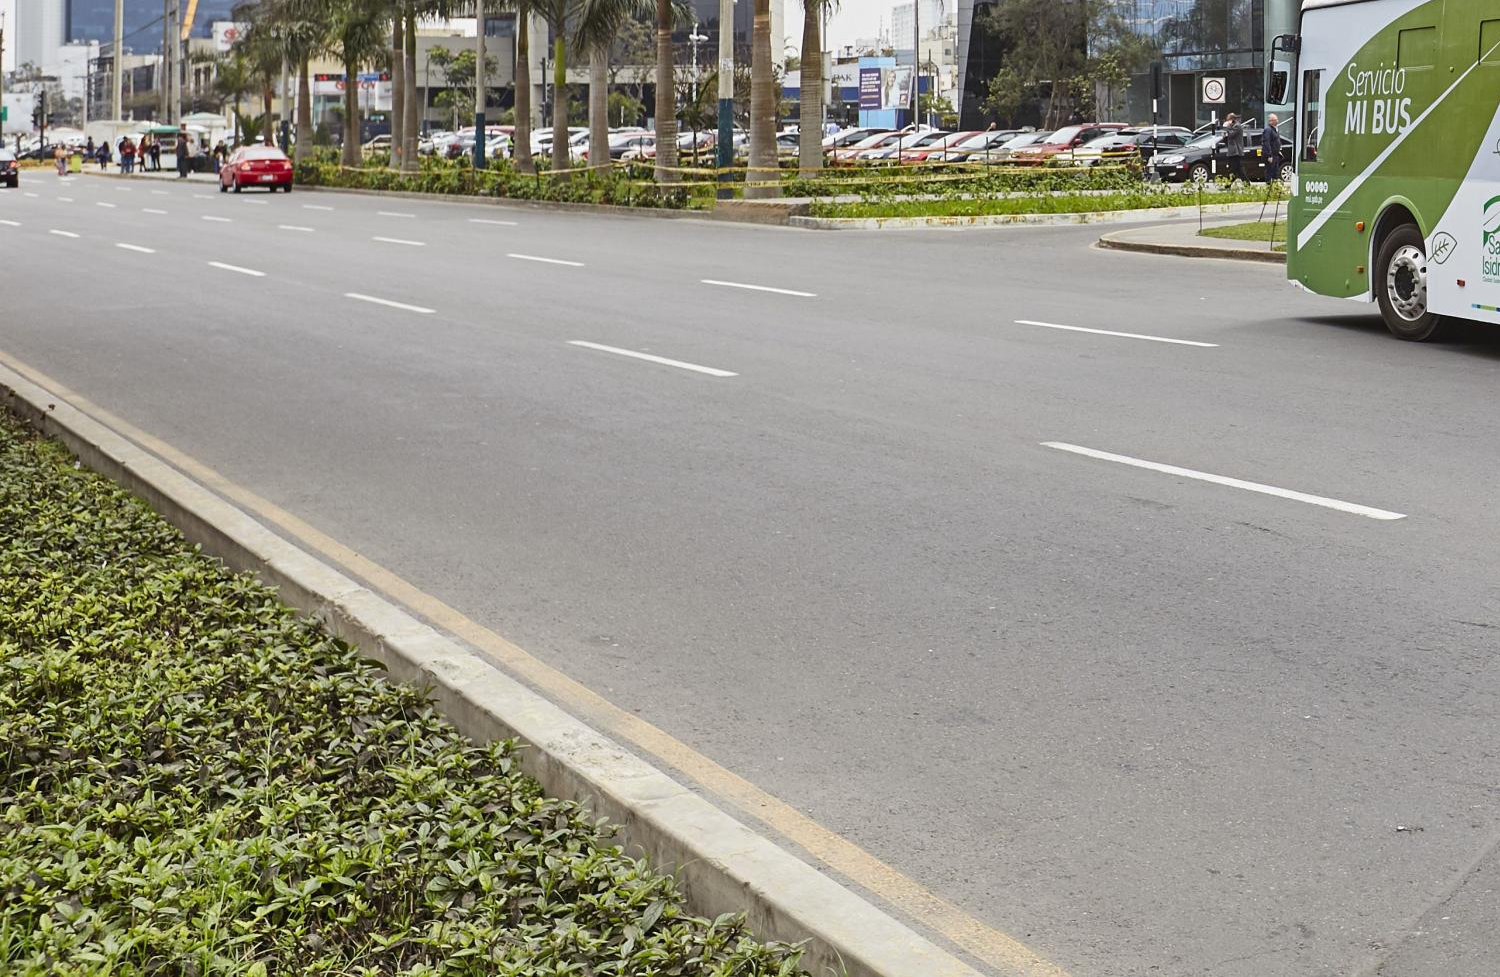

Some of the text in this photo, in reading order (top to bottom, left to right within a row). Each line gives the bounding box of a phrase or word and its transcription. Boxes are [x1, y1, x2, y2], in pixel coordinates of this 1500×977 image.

[1345, 60, 1406, 97] Servicio
[1344, 97, 1412, 135] MI BUS
